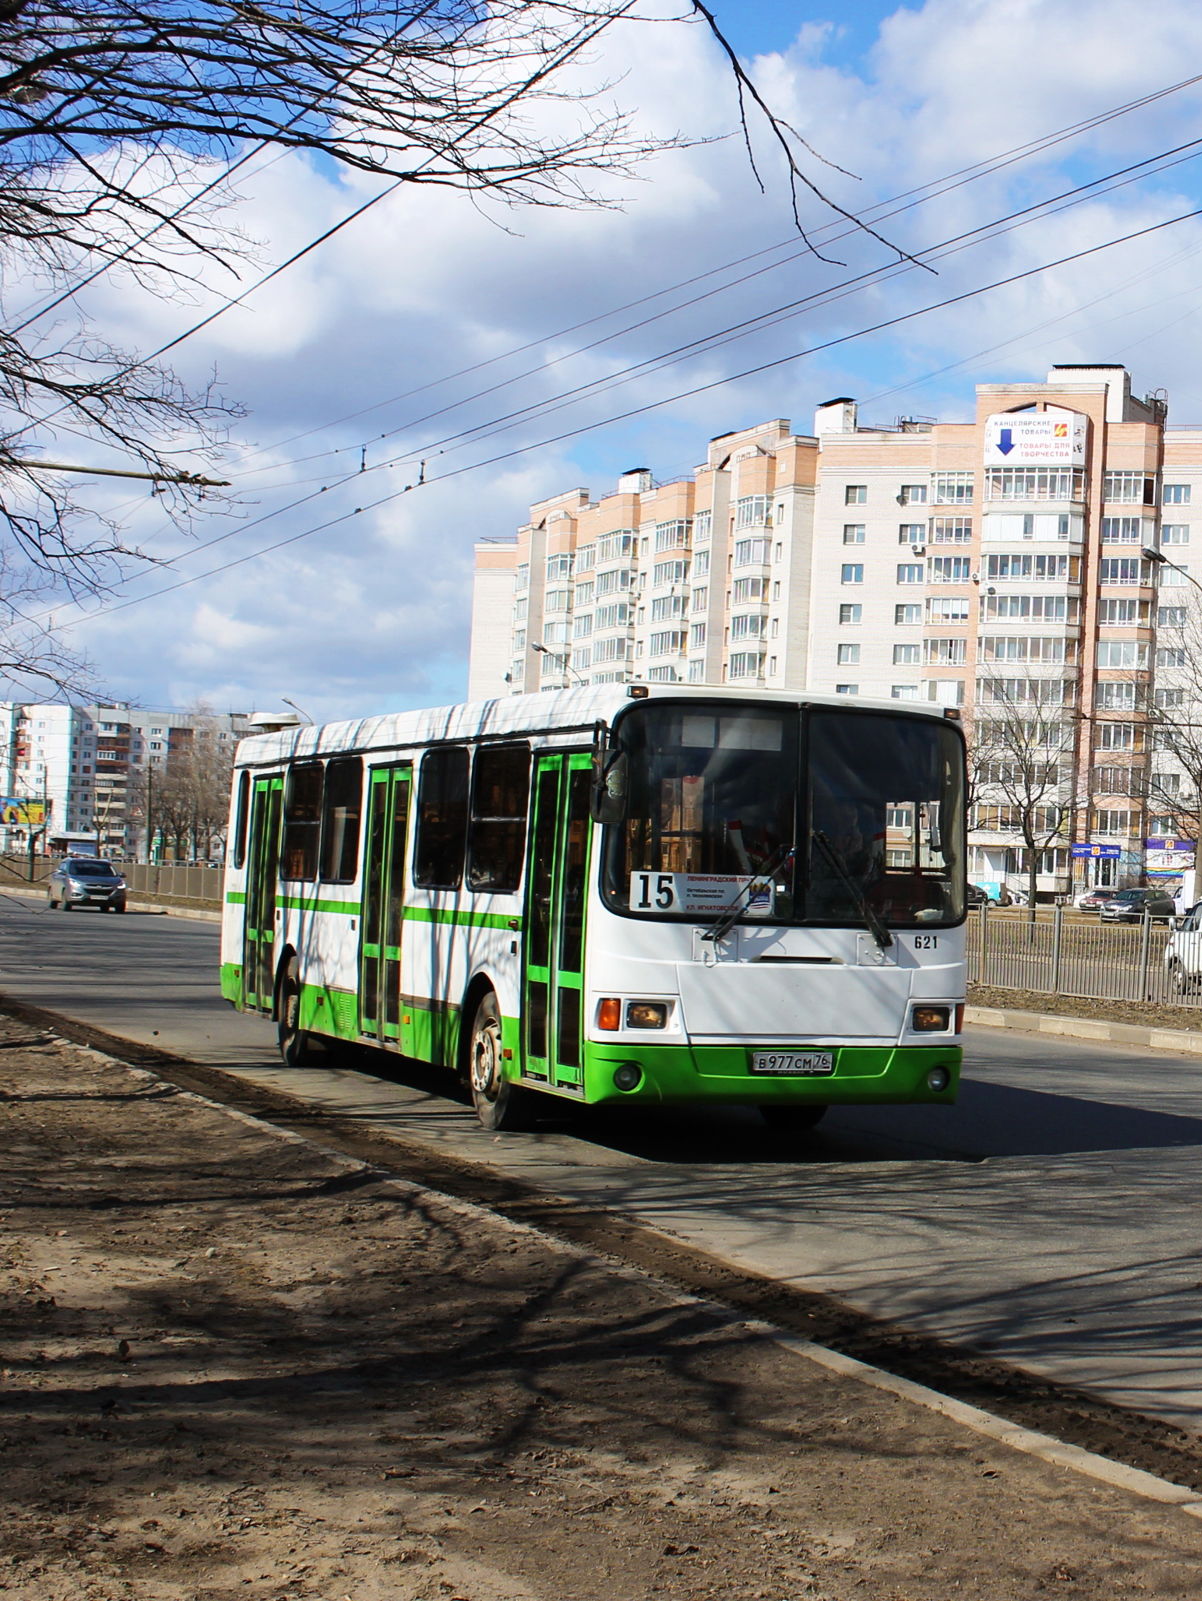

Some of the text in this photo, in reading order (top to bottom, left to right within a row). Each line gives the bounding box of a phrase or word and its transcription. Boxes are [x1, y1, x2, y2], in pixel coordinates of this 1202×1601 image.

[638, 874, 674, 909] 15
[914, 935, 938, 949] 621
[815, 1055, 828, 1065] 76
